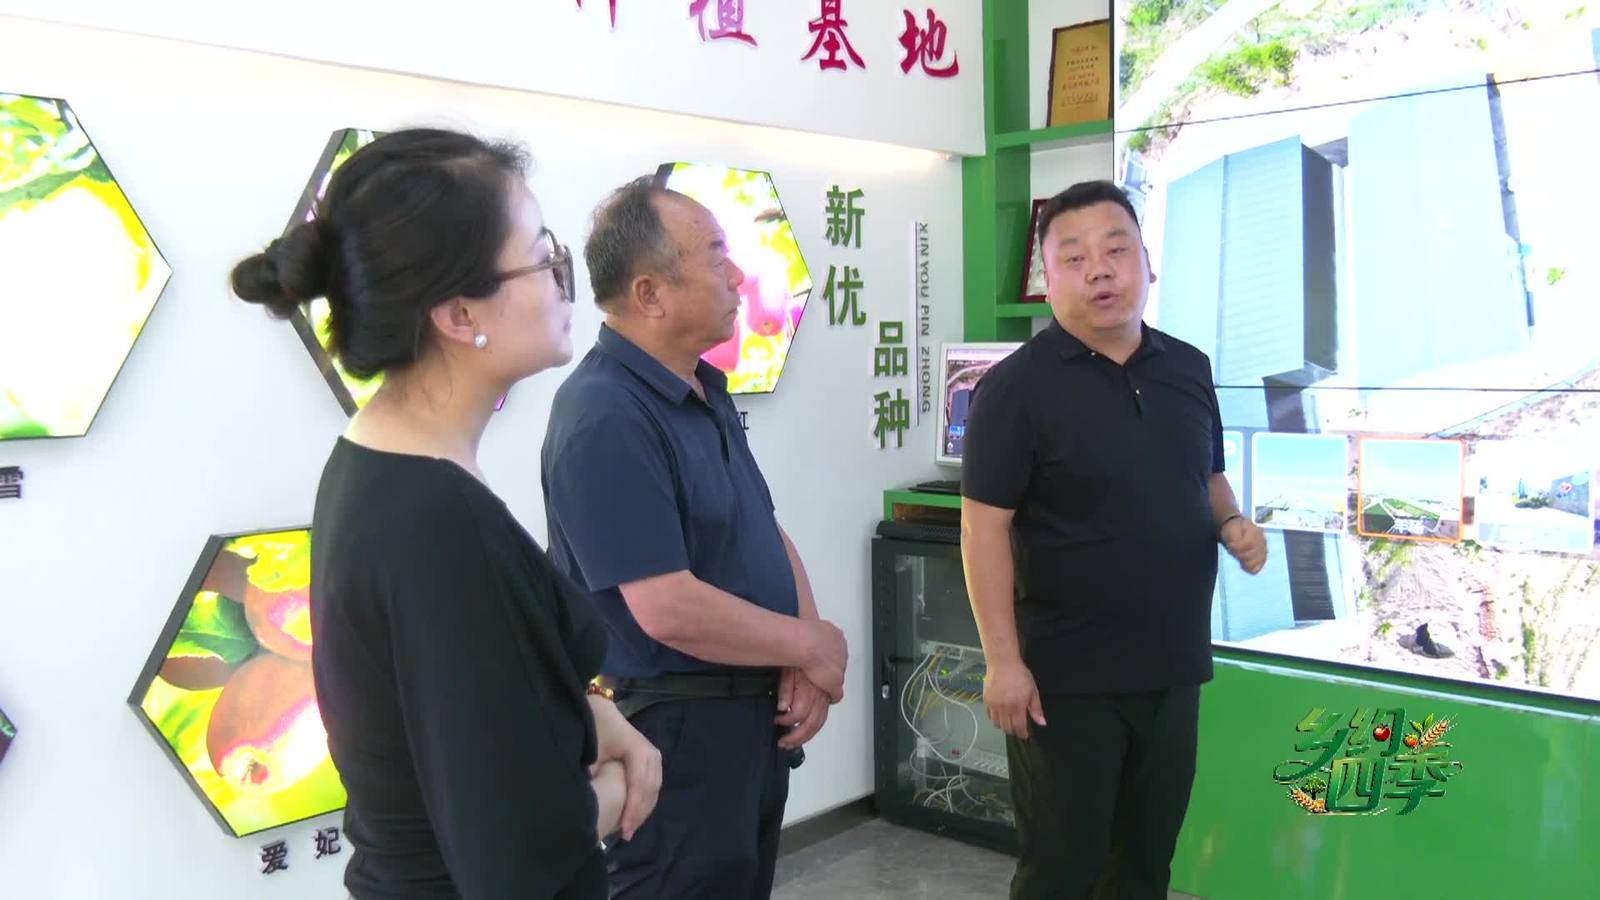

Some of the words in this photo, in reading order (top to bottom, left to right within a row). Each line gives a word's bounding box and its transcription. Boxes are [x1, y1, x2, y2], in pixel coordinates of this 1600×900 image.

[577, 0, 960, 78] 植基地
[823, 185, 867, 326] 新优
[919, 222, 929, 257] XIN
[920, 261, 930, 299] YOU
[920, 304, 930, 337] PIN
[873, 321, 910, 450] 品种
[920, 345, 931, 414] ZHONG
[260, 827, 342, 874] 爱妃
